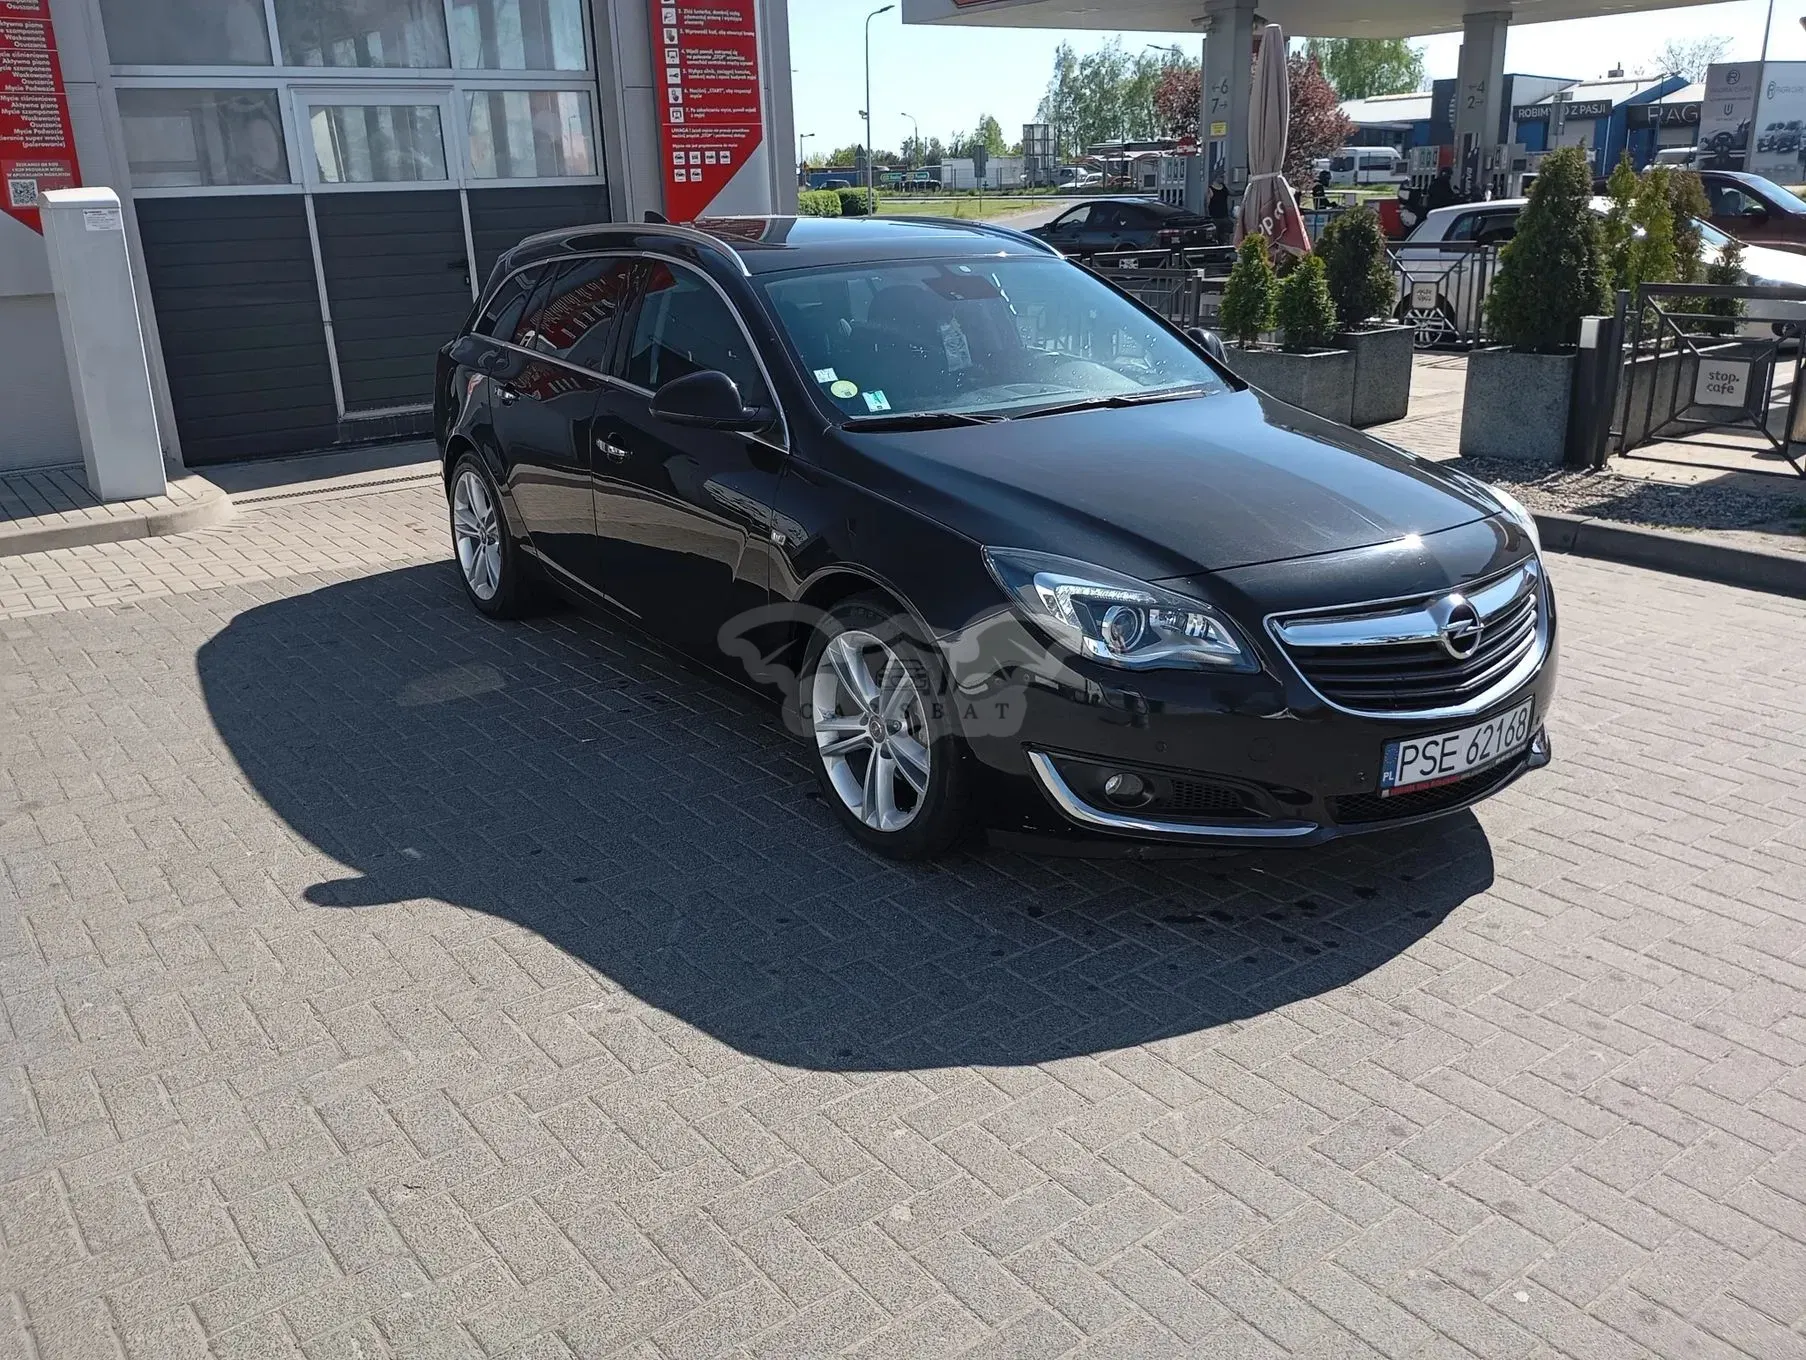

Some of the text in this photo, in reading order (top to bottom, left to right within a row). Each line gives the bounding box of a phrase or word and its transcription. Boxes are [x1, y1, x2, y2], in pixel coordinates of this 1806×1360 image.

[1221, 78, 1228, 94] 6
[1212, 98, 1219, 114] 7
[1468, 96, 1475, 109] 2
[1571, 105, 1578, 115] Z
[1580, 103, 1606, 114] PASJI
[1706, 382, 1735, 395] cafe
[1397, 734, 1460, 782] PSE
[1465, 707, 1529, 765] 62168
[1382, 771, 1395, 783] PL
